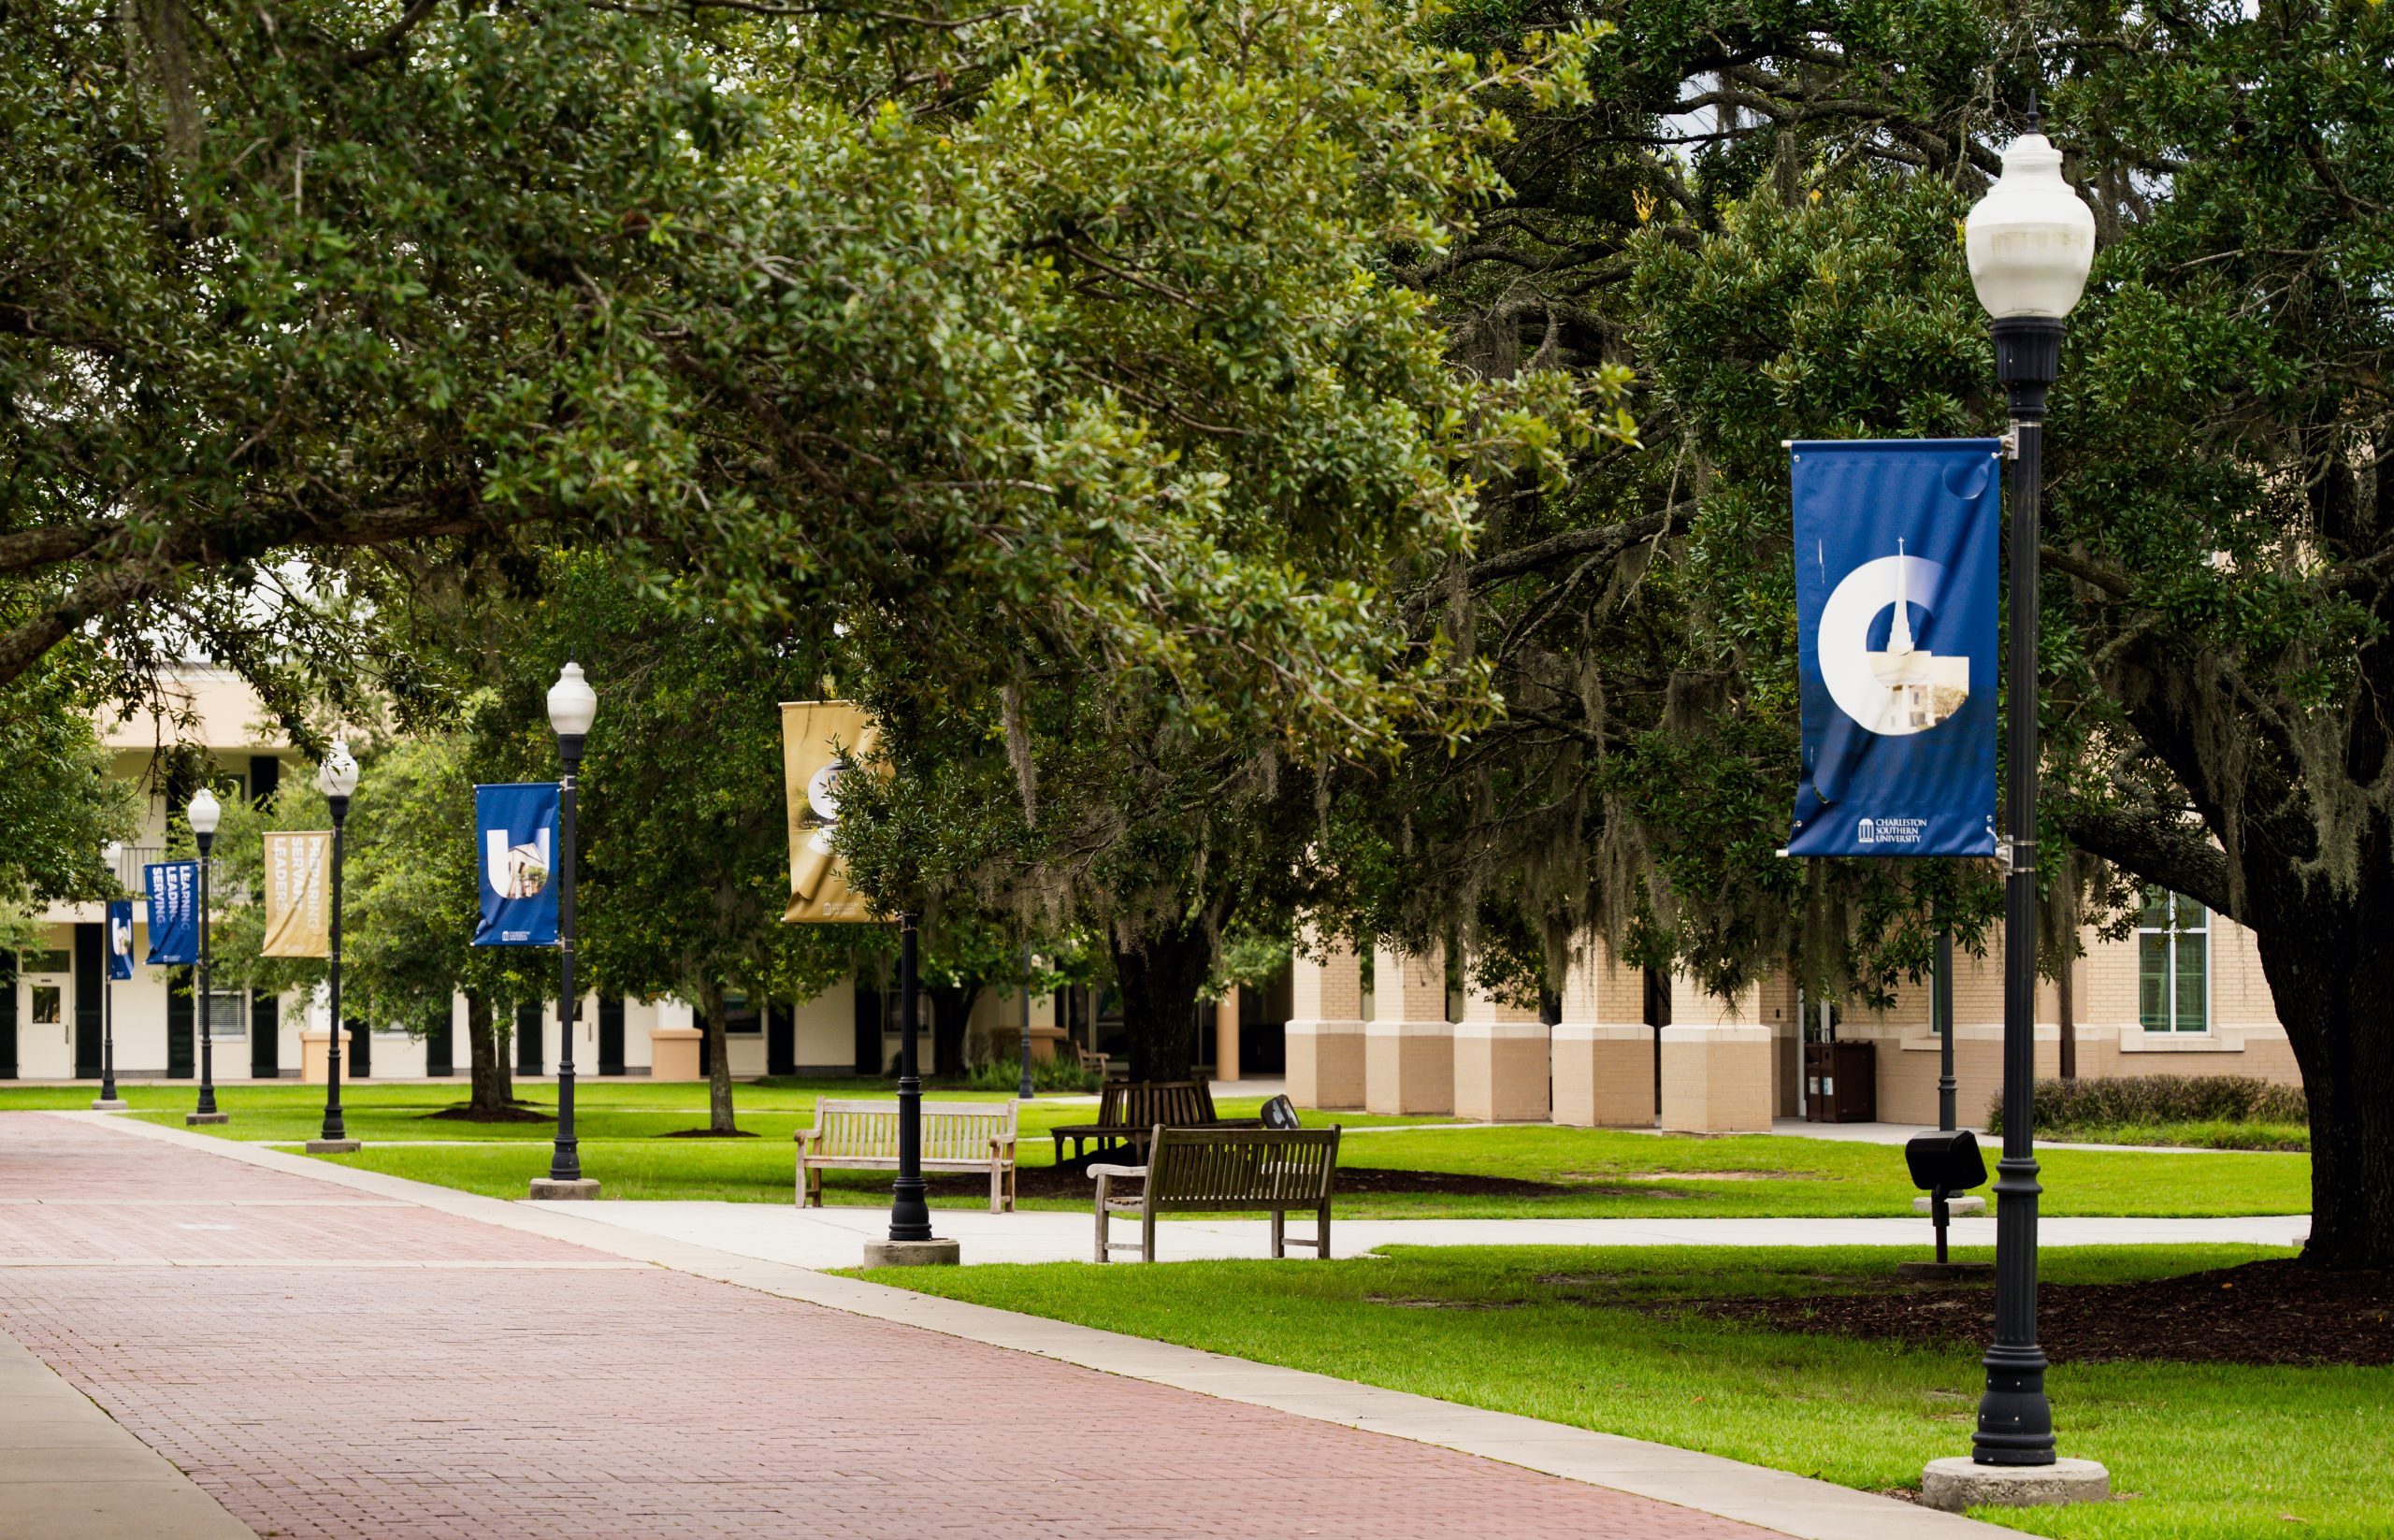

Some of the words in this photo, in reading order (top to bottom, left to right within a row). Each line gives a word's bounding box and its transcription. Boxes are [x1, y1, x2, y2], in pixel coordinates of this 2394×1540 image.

[1875, 818, 1926, 827] CHARLESTON
[308, 837, 321, 928] PREPARING
[486, 827, 551, 900] U
[152, 867, 166, 927] SERVING.
